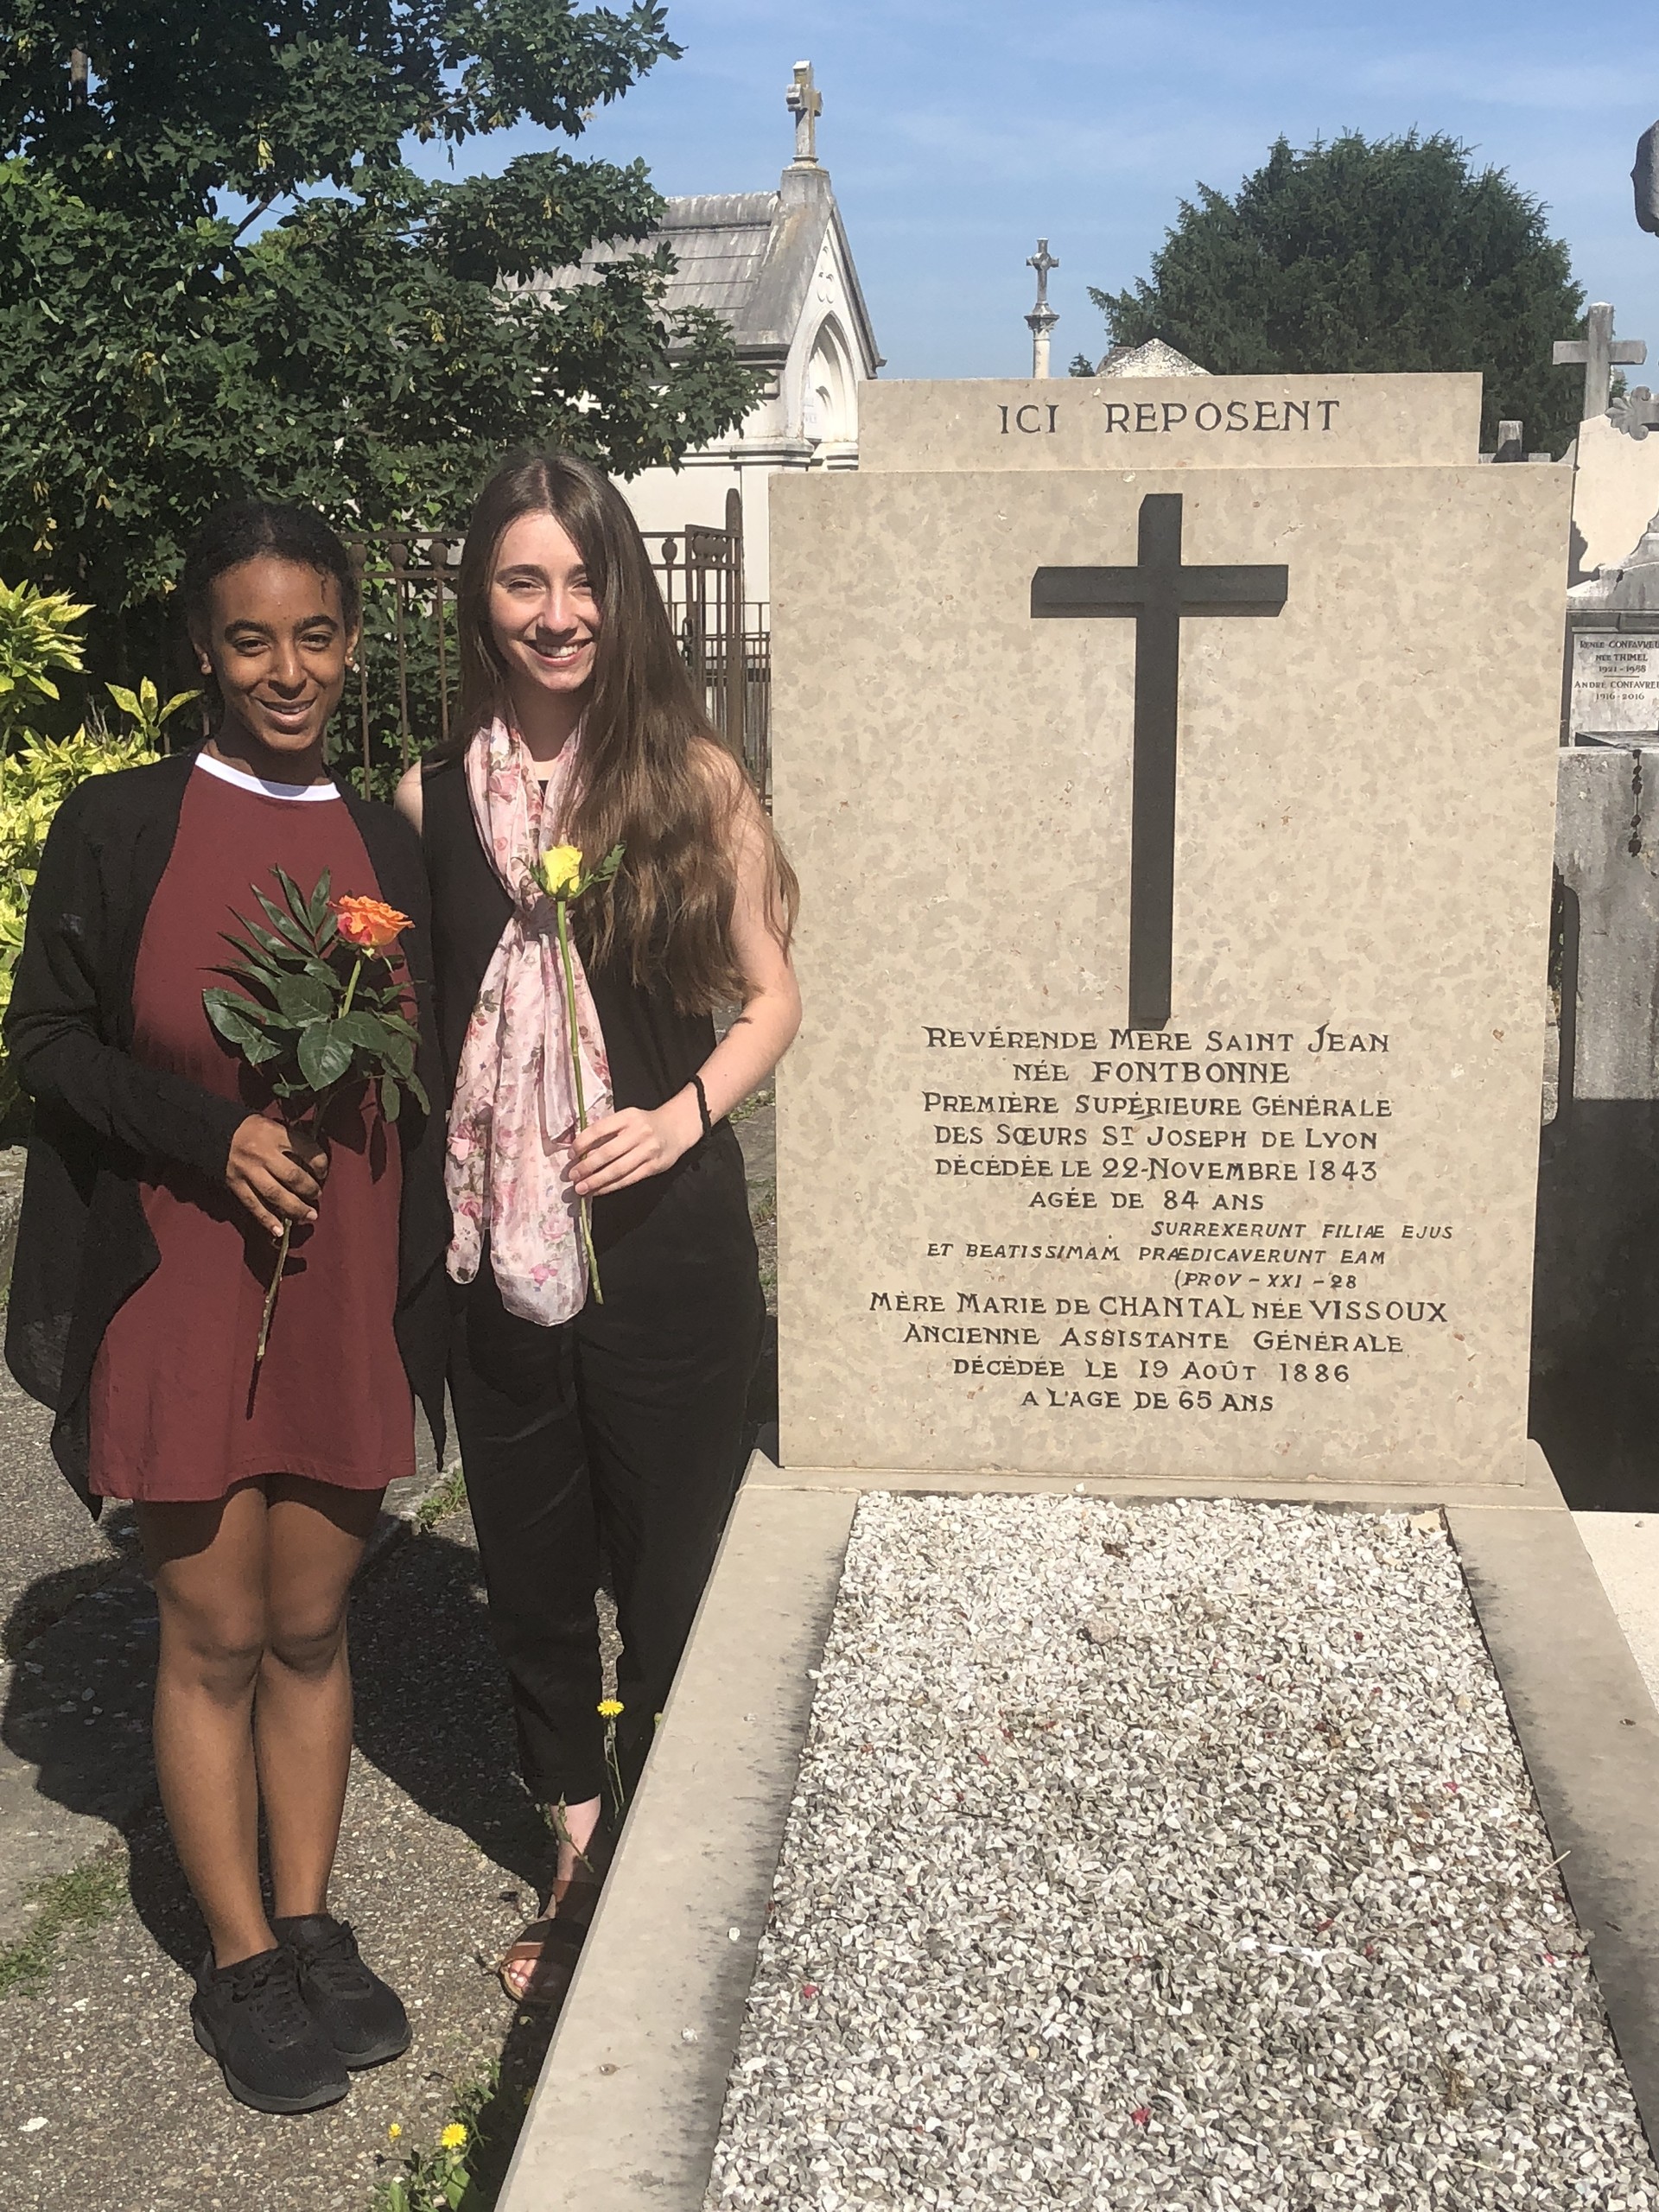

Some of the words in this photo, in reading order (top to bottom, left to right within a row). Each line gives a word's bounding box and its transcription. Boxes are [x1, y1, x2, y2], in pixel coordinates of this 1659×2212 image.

[997, 404, 1058, 434] ICI
[1103, 400, 1339, 433] REPOSENT
[1205, 1031, 1294, 1052] SAINT
[1308, 1020, 1389, 1052] JEAN
[1013, 1059, 1069, 1082] NÉE
[1091, 1062, 1289, 1084] FONTBONNE
[1075, 1091, 1241, 1120] SUPÉRIEURE
[1253, 1095, 1391, 1116] GÉNÉRALE
[934, 1125, 982, 1144] DES
[997, 1124, 1086, 1146] SŒURS
[1147, 1127, 1246, 1147] JOSEPH
[1262, 1132, 1294, 1147] DE
[1306, 1128, 1376, 1149] LYON
[935, 1154, 1052, 1177] DÉCÉDÉE
[1062, 1160, 1091, 1177] LE
[1309, 1160, 1376, 1181] 1843
[1028, 1187, 1097, 1208] AGÉE
[1110, 1192, 1143, 1208] DE
[1164, 1190, 1198, 1210] 84
[1212, 1194, 1263, 1210] ANS
[1151, 1221, 1306, 1238] SURREXERUNT
[1322, 1224, 1384, 1238] FILIÆ
[1402, 1225, 1452, 1239] EJUS
[927, 1243, 953, 1256] ET
[966, 1244, 1120, 1261] BEATISSIMAM
[1139, 1247, 1326, 1263] PRÆDICAVERUNT
[1340, 1249, 1384, 1264] EAM
[1175, 1269, 1242, 1290] (PROV
[1267, 1274, 1301, 1288] XXI
[1331, 1274, 1356, 1290] 28
[869, 1291, 945, 1312] MÈRE
[957, 1292, 1046, 1313] MARIE
[1056, 1299, 1090, 1315] DE
[1100, 1294, 1244, 1321] CHANTAL
[1252, 1298, 1302, 1319] NÉE
[1309, 1300, 1447, 1322] VISSOUX
[903, 1322, 1040, 1344] ANCIENNE
[1059, 1327, 1228, 1349] ASSISTANTE
[1254, 1330, 1402, 1352] GÉNÉRALE
[952, 1355, 1065, 1376] DÉCÉDÉE
[1085, 1358, 1117, 1379] LE
[1140, 1359, 1167, 1378] 19
[1180, 1360, 1256, 1380] AOÛT
[1280, 1363, 1349, 1382] 1886
[1021, 1391, 1039, 1406] A
[1046, 1388, 1121, 1408] L'AGE
[1133, 1391, 1169, 1410] DE
[1179, 1391, 1211, 1409] 65
[1219, 1394, 1273, 1412] ANS
